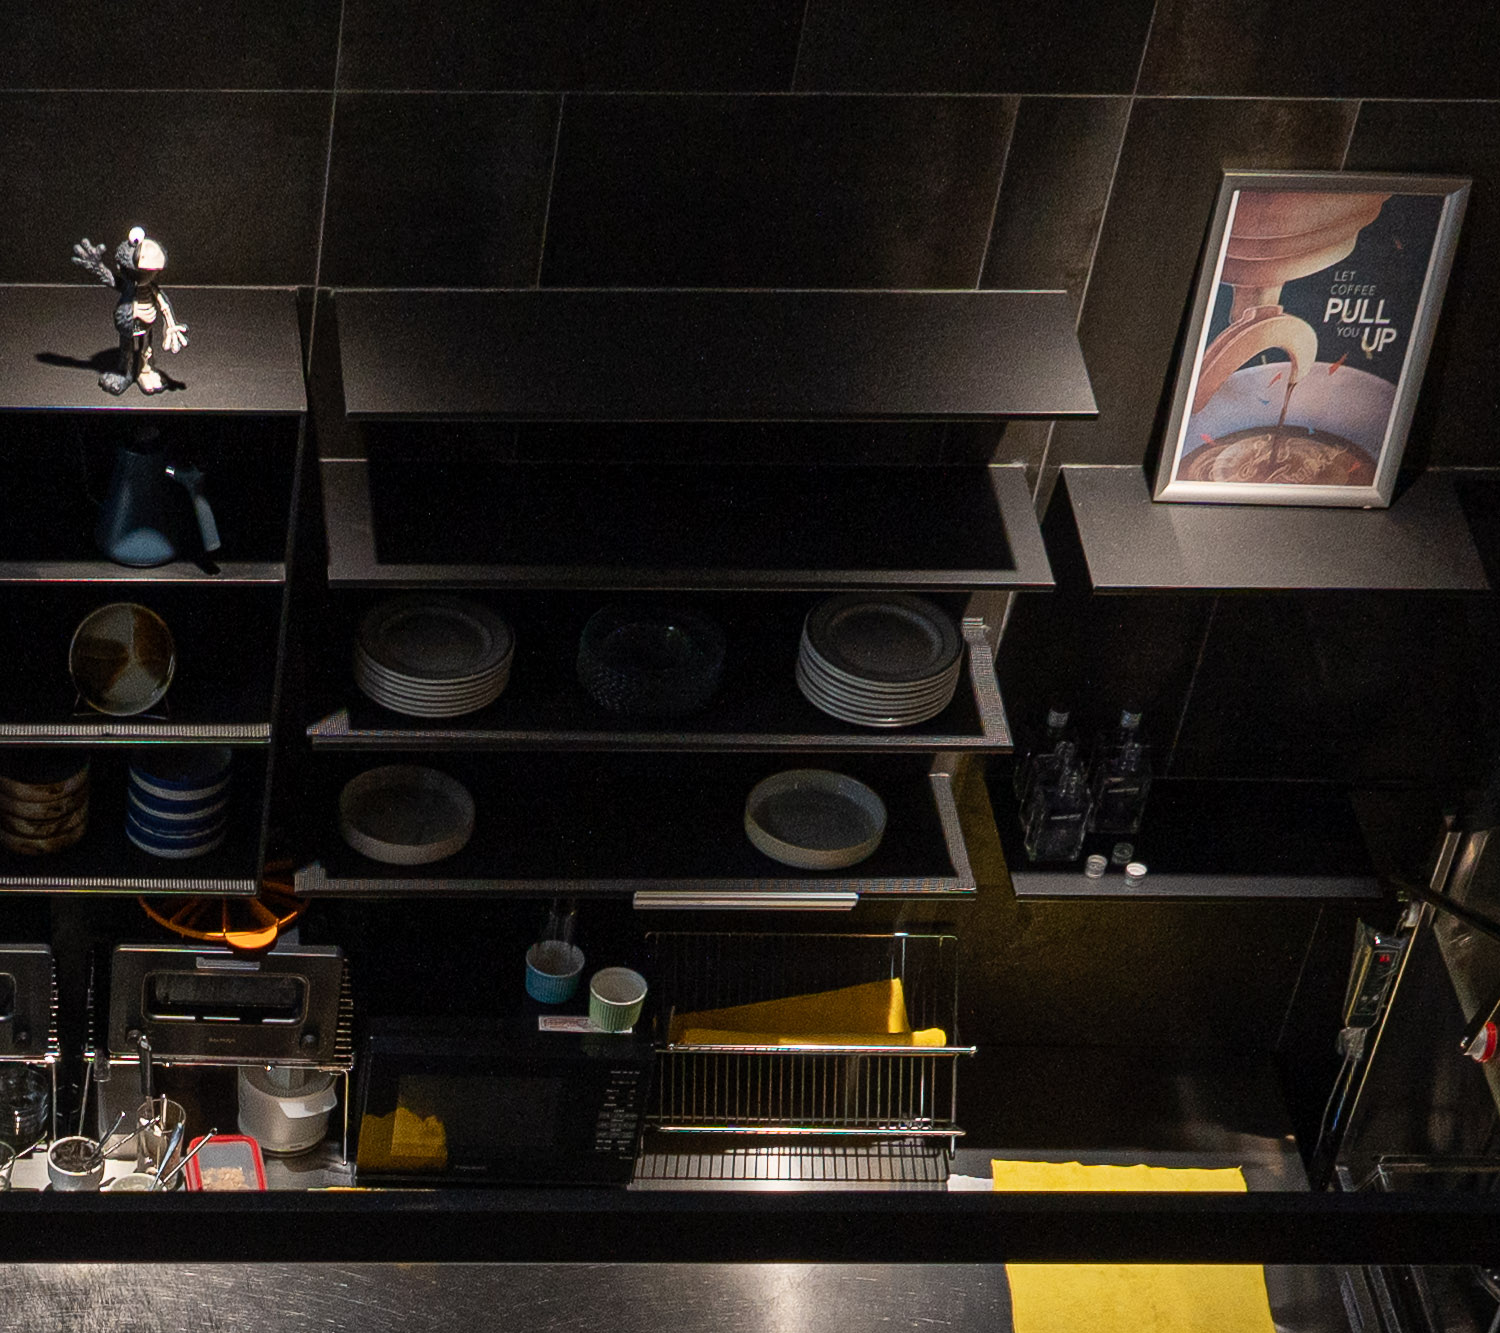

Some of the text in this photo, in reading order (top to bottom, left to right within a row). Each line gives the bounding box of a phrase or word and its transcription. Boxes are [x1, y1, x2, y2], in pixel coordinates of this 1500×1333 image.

[1335, 271, 1356, 282] LET
[1330, 284, 1376, 296] COFFEE
[1323, 298, 1390, 324] PULL
[1336, 326, 1397, 354] YOU UP
